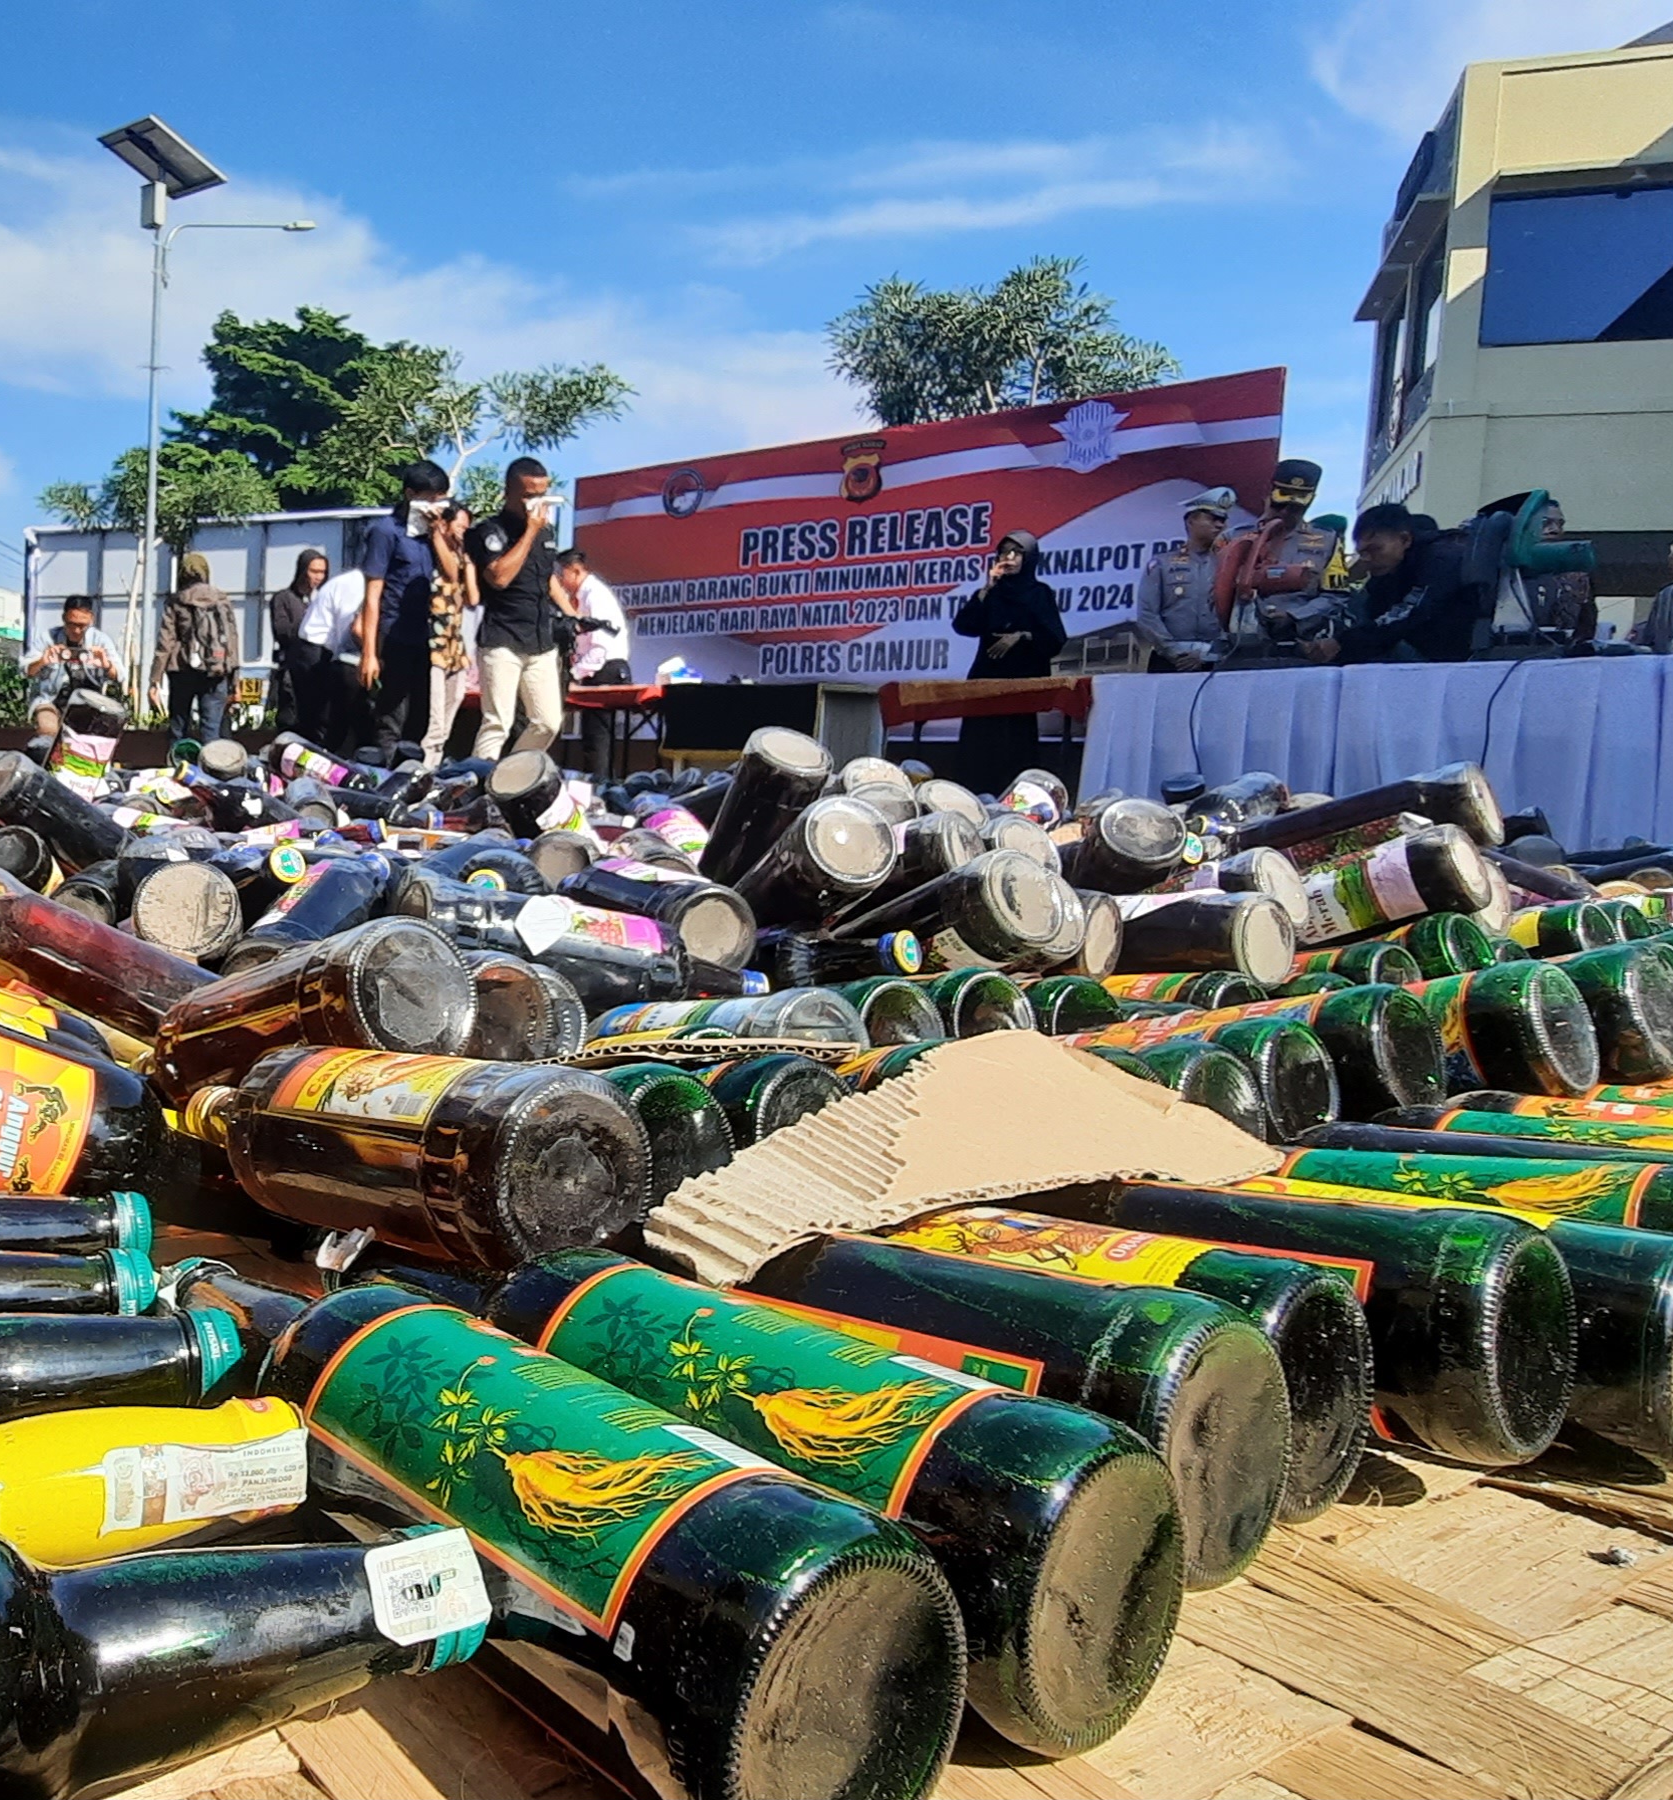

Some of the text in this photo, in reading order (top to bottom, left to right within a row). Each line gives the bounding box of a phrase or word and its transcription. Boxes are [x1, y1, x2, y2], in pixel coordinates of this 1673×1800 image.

[740, 504, 991, 567] PRESS RELEASE
[1037, 543, 1145, 577] KNALPOT
[685, 577, 753, 604] BARANG
[757, 571, 810, 596] BUKTI
[814, 563, 912, 592] MINUMAN
[913, 557, 981, 586] KERAS
[1077, 583, 1134, 612] 2024
[636, 612, 716, 637] MENJELANG
[719, 608, 755, 632] HARI
[759, 605, 797, 630] RAYA
[801, 602, 851, 627] NATAL
[852, 598, 899, 624] 2023
[904, 596, 942, 621] DAN
[760, 638, 950, 675] POLRES CIANJUR
